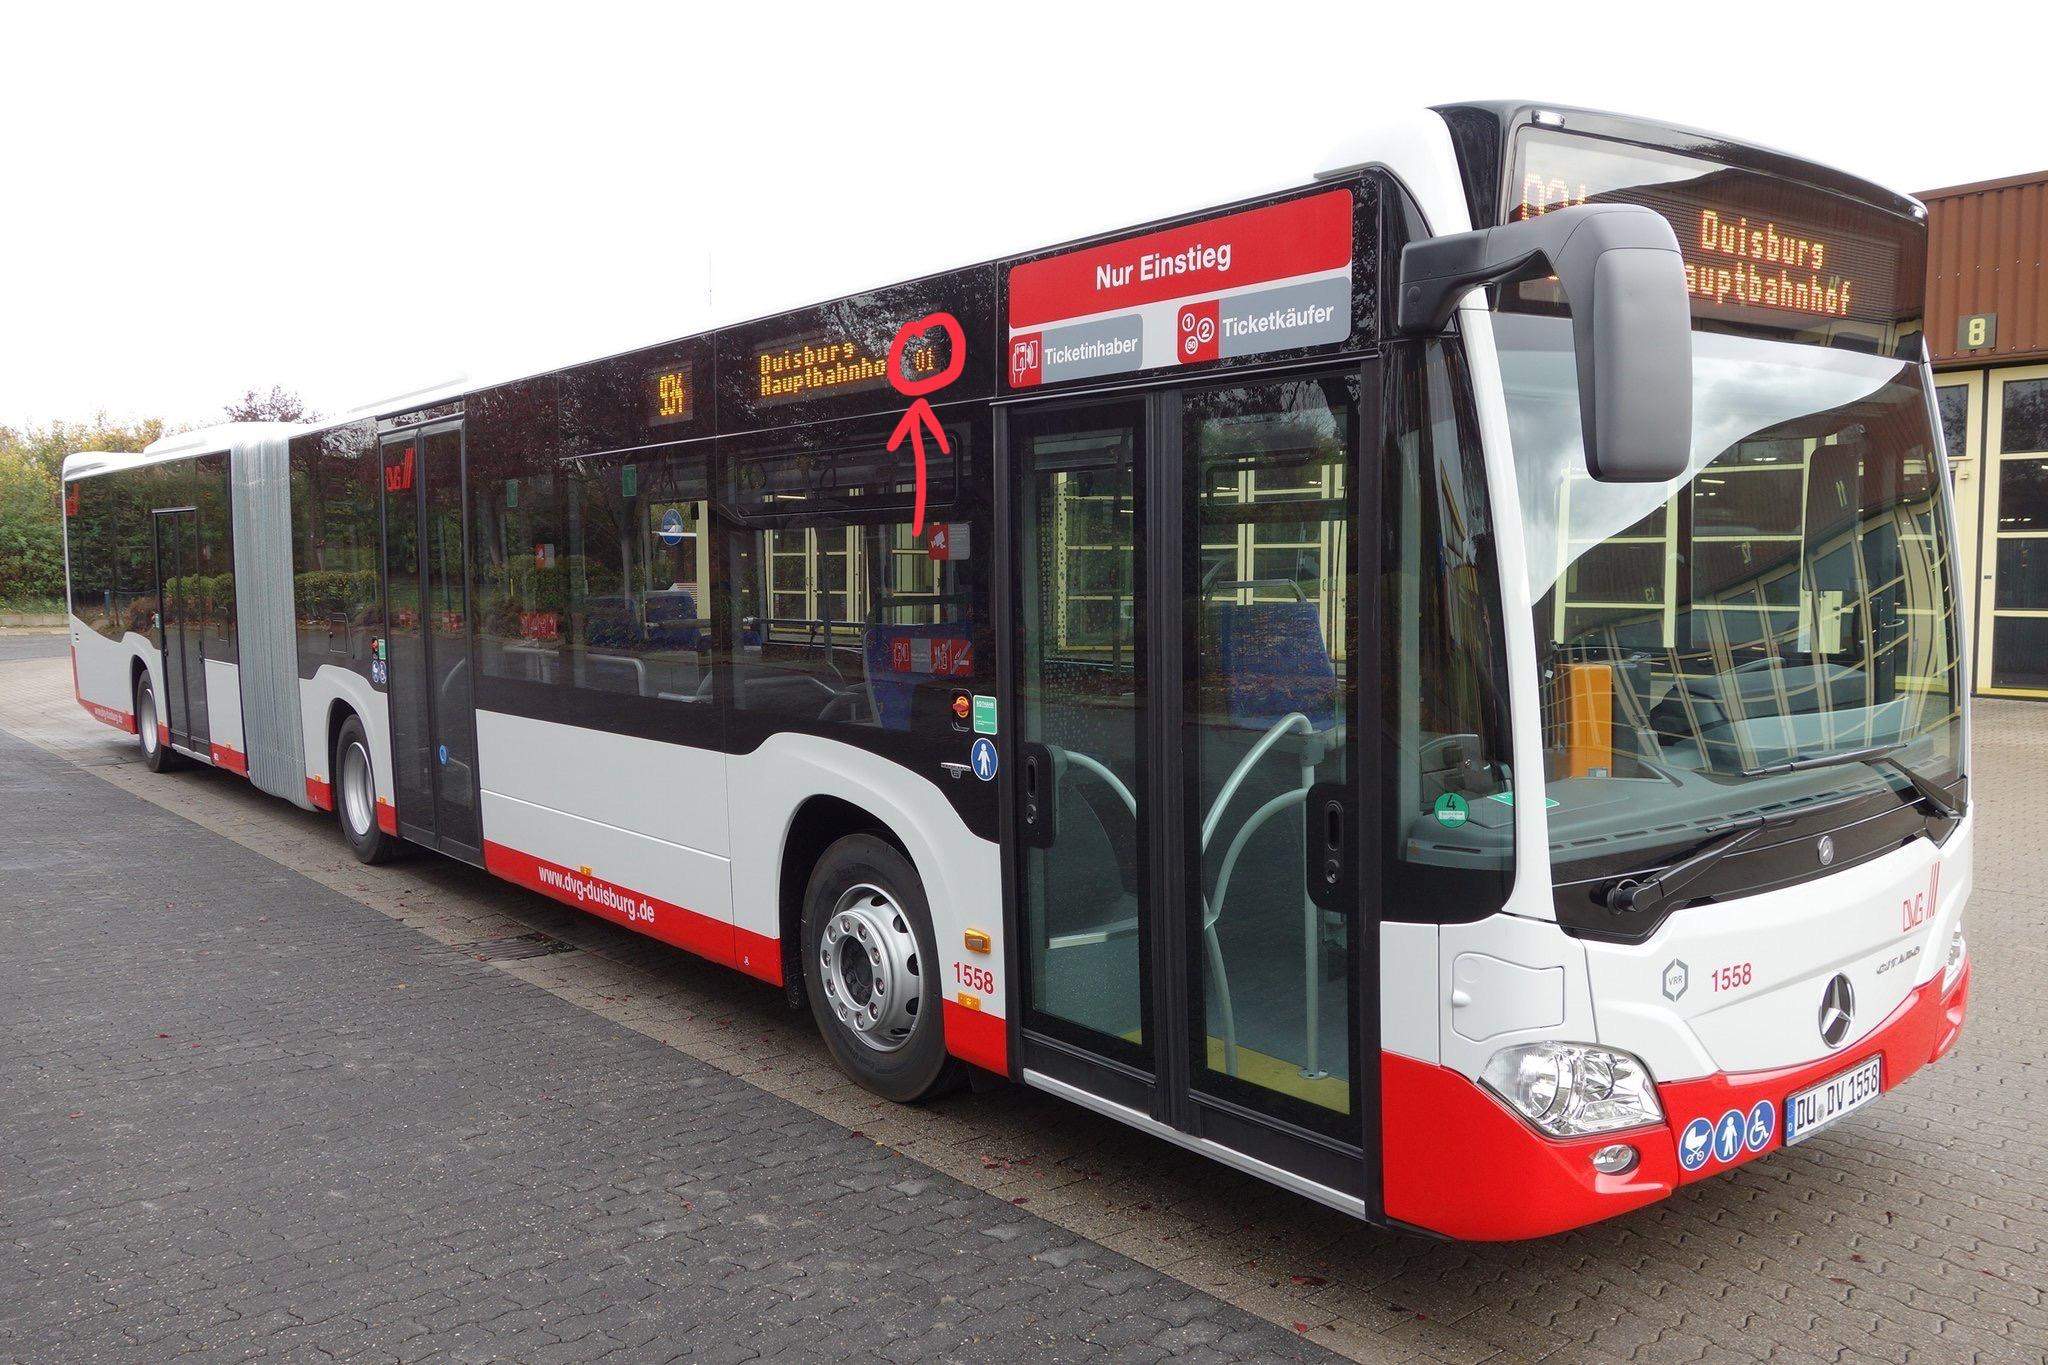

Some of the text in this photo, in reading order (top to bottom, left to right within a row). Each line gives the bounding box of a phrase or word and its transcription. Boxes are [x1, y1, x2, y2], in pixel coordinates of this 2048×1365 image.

[1701, 209, 1825, 271] Duisburg
[1096, 243, 1232, 291] Nur Einstieg
[1685, 261, 1851, 316] auptbahnhof
[1222, 304, 1335, 337] Ticketkäufer
[1969, 318, 1986, 346] 8
[760, 342, 855, 375] Duisburg
[1044, 337, 1138, 365] Ticketinhaber
[760, 357, 887, 396] Hauptbahnho
[660, 373, 684, 416] 934
[1446, 794, 1457, 810] 4
[538, 864, 656, 924] www.dvg-duisburg.de
[953, 961, 995, 996] 1558
[1668, 975, 1683, 987] VRR
[1712, 962, 1753, 993] 1558
[1797, 1063, 1879, 1131] DU DV 1558
